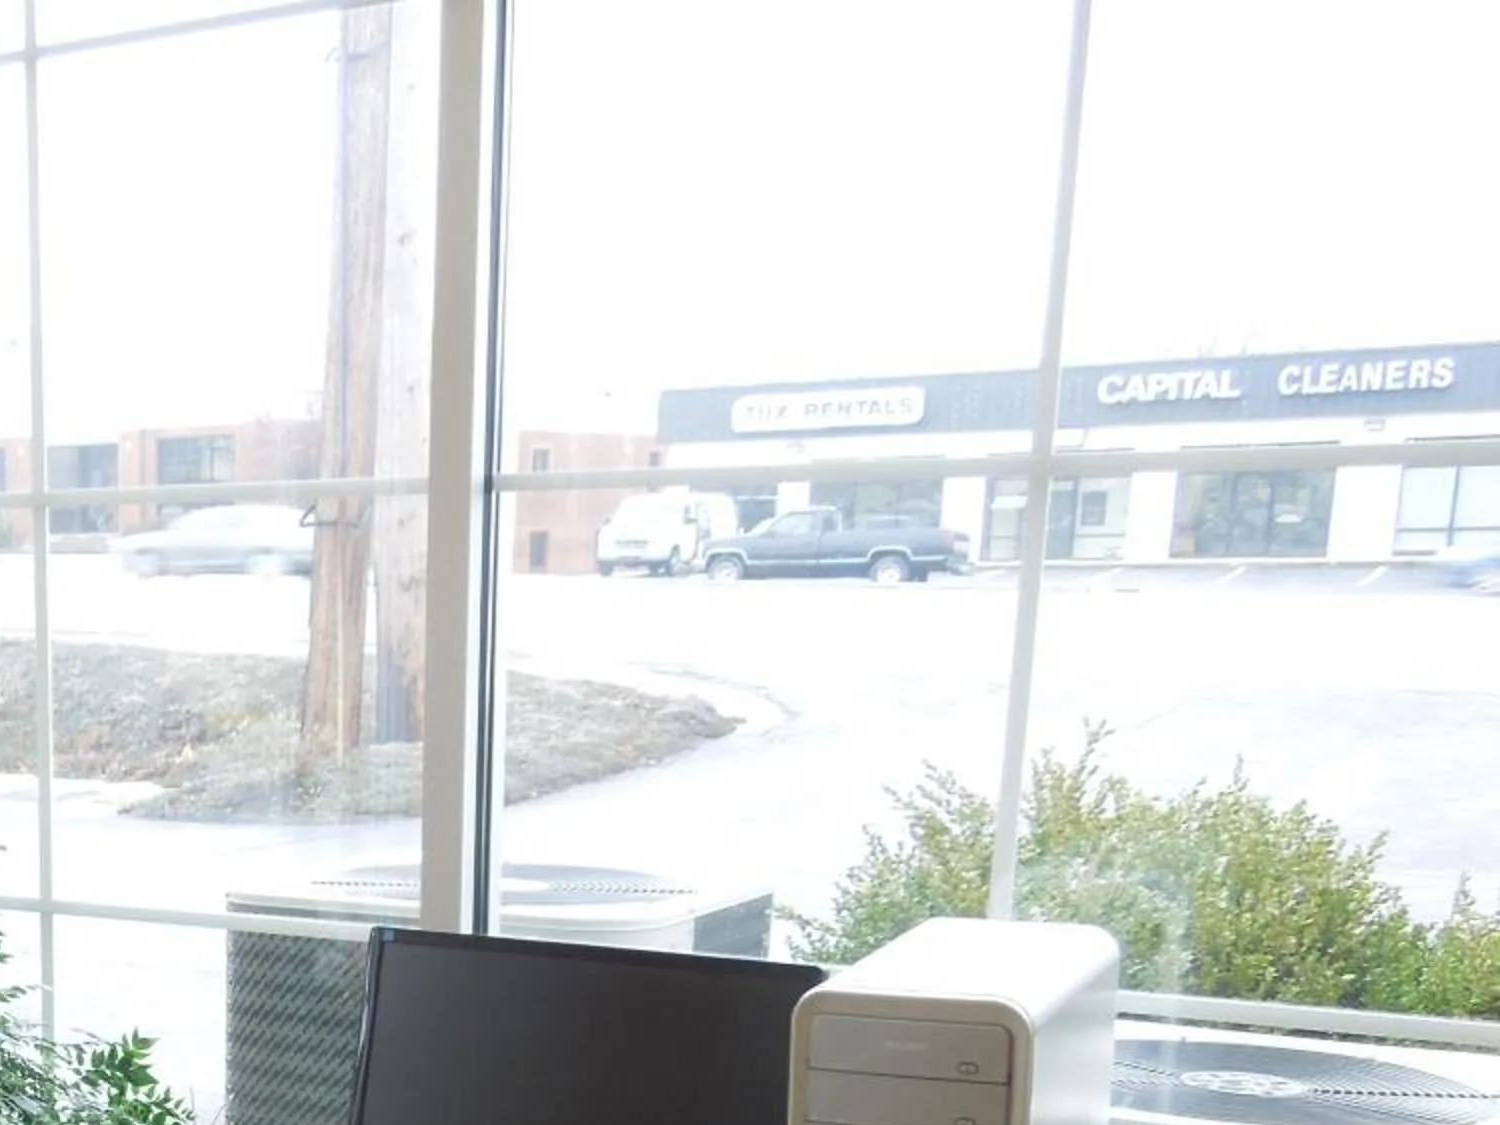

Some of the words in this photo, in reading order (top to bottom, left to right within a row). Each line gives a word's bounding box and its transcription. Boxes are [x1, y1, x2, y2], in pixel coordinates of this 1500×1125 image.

[1097, 370, 1242, 405] CAPITAL
[1277, 356, 1455, 396] CLEANERS
[803, 397, 913, 418] RENTALS
